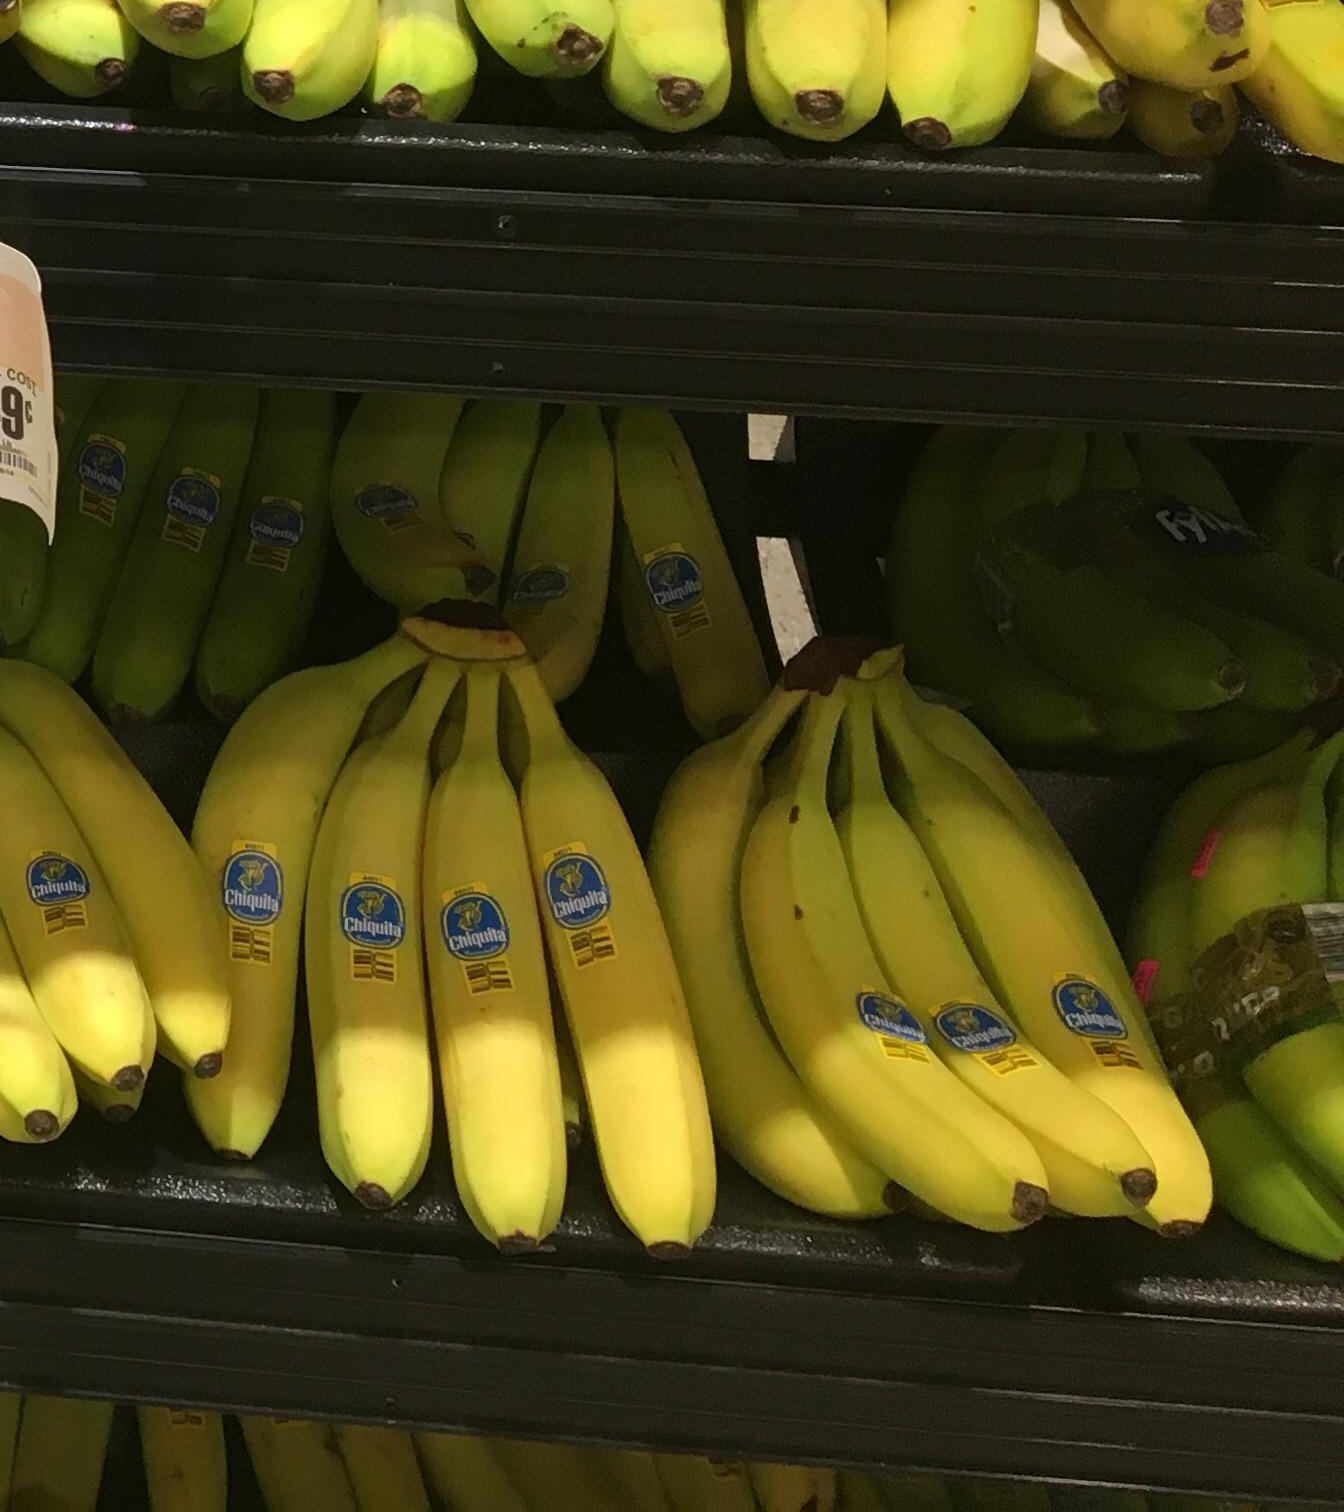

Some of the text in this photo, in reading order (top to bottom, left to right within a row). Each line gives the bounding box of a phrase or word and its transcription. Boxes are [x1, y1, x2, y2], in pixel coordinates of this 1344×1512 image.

[6, 368, 37, 398] COST
[167, 495, 213, 520] Chiquita
[654, 582, 702, 604] Chiquita
[31, 880, 86, 898] Chiquita
[225, 890, 279, 912] Chiquita
[552, 892, 607, 918] Chiquita
[345, 917, 401, 937] Chiquita
[449, 928, 506, 951] Chiquita
